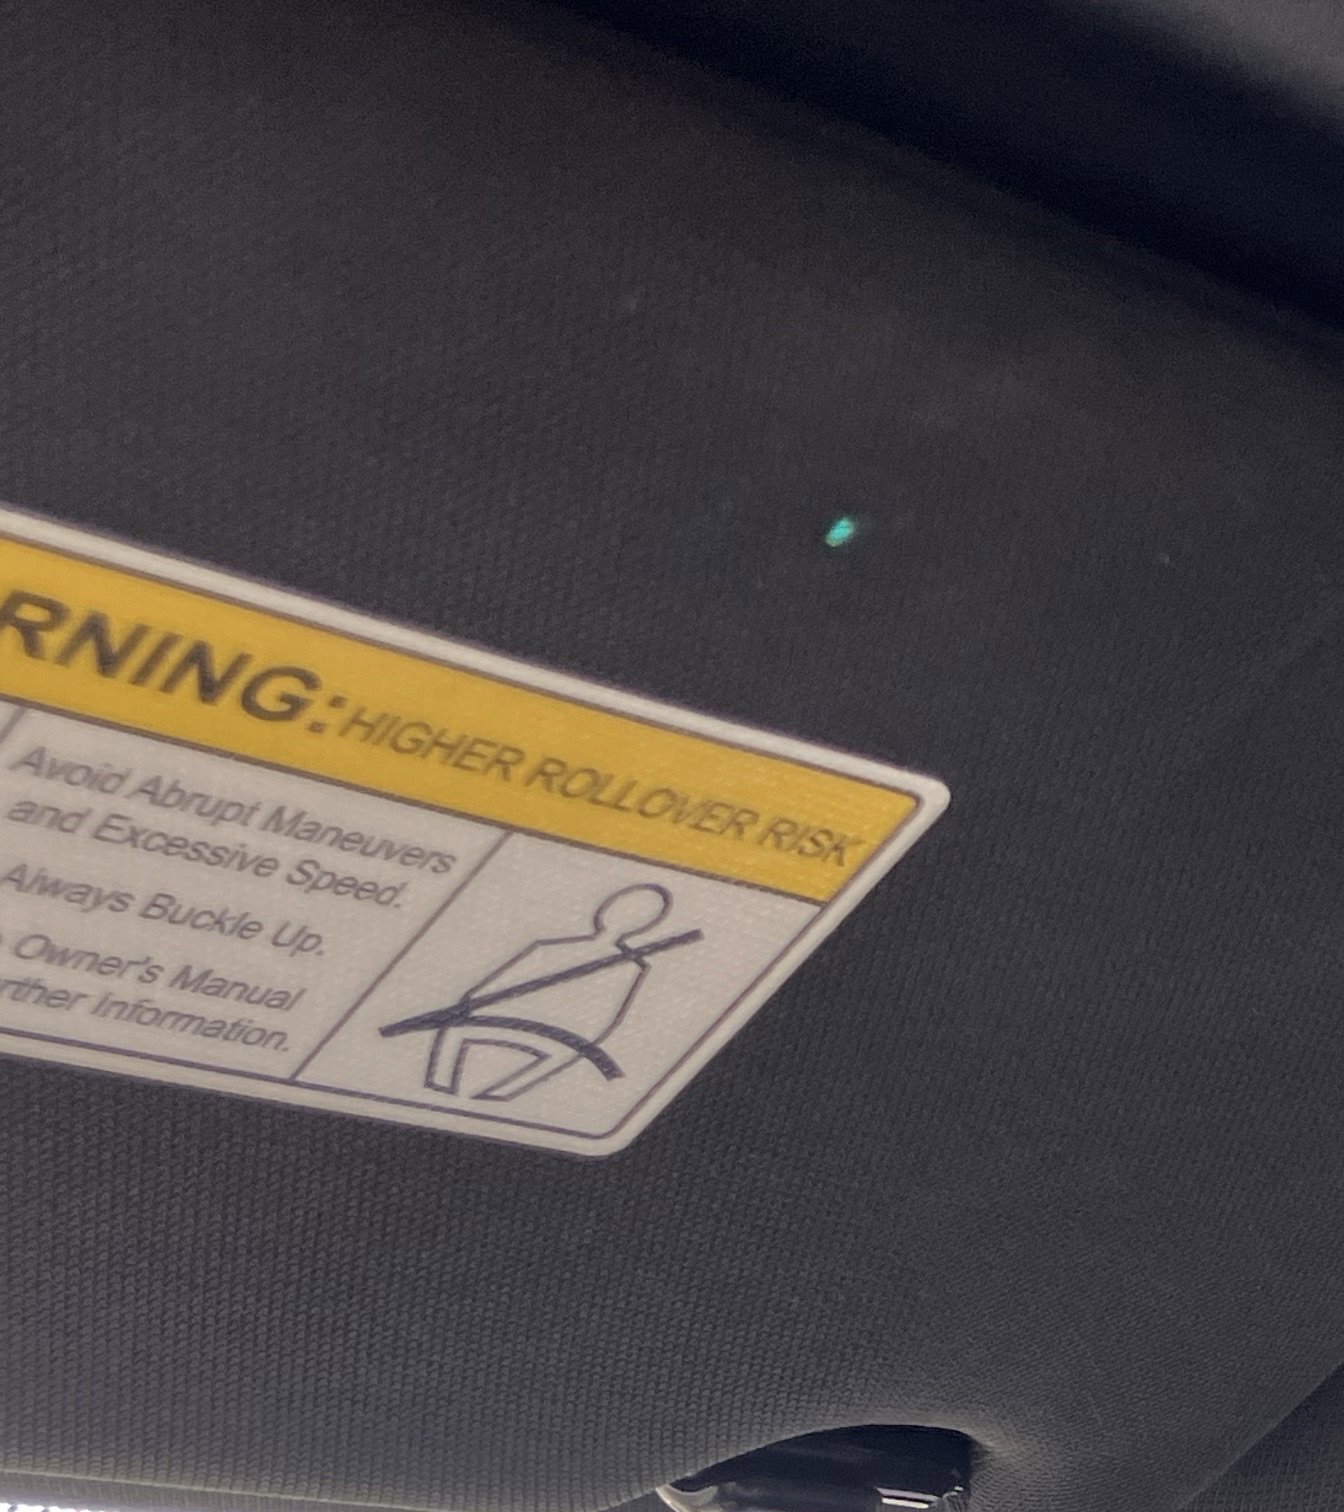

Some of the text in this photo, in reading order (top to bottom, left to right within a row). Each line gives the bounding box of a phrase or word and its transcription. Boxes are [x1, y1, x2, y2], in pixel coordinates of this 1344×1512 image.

[8, 745, 458, 874] Avoid Abrupt Maneuvers
[338, 706, 524, 784] HIGHER
[525, 755, 760, 833] ROLLOVER
[757, 816, 868, 868] RISK
[6, 799, 410, 908] and Excessive Speed.
[1, 863, 325, 957] Always Buckle Up.
[13, 933, 308, 1011] Owner's Manual
[91, 991, 289, 1052] Information.
